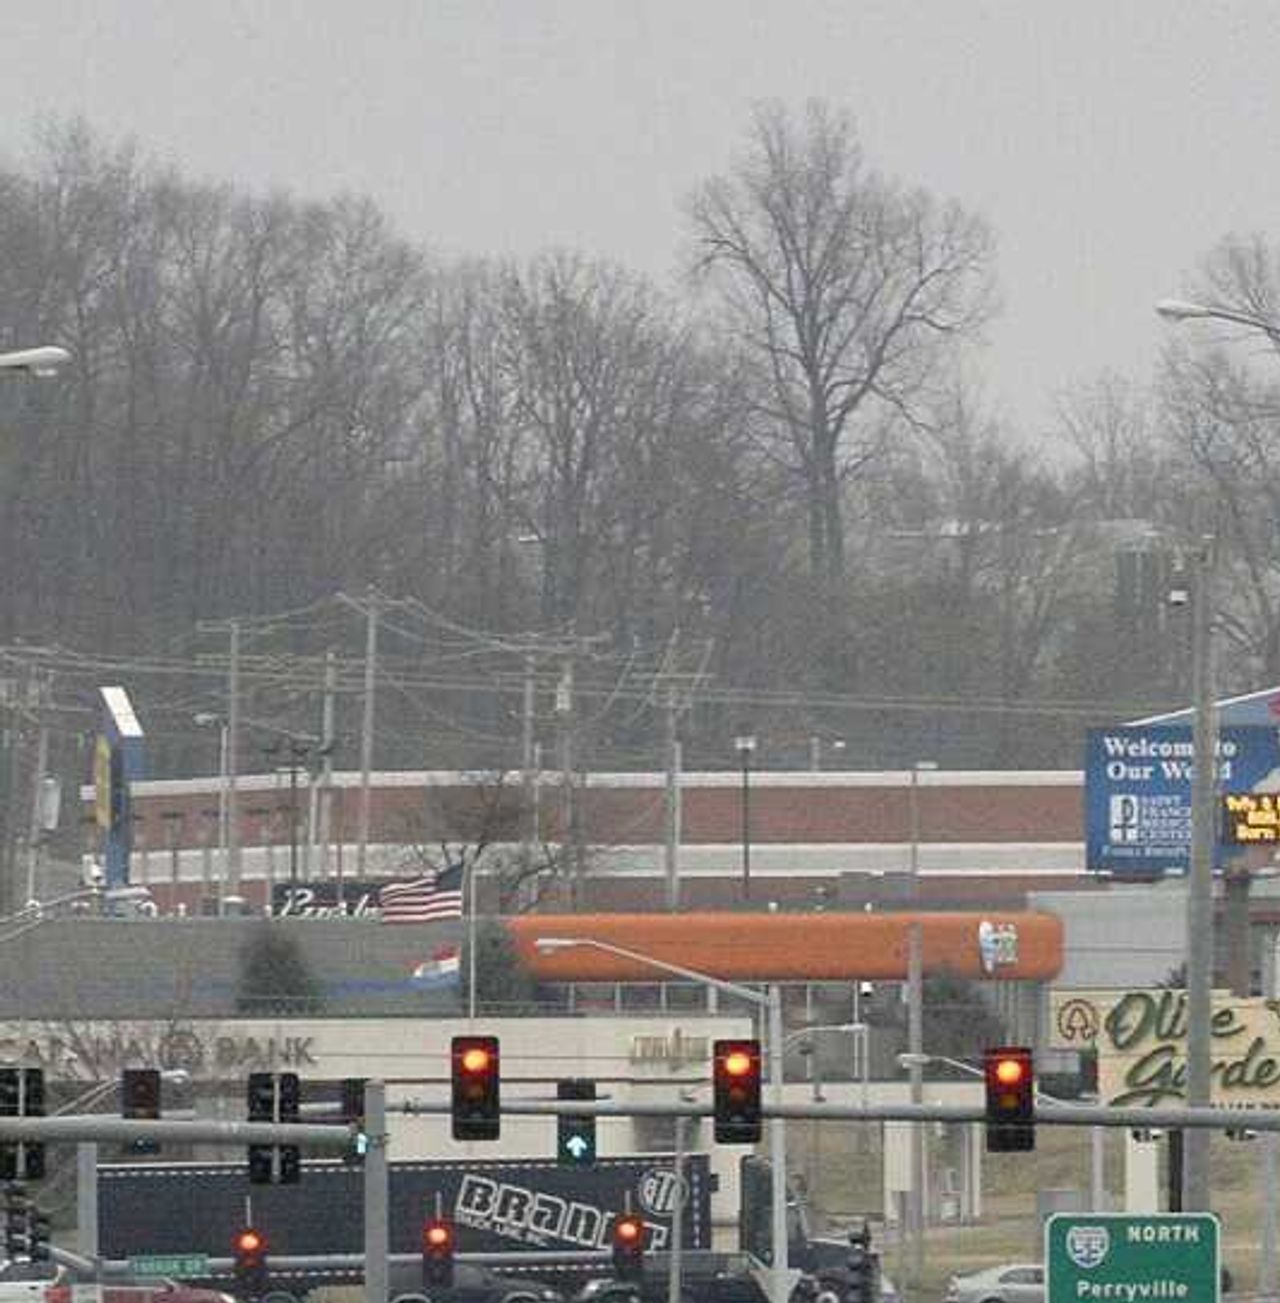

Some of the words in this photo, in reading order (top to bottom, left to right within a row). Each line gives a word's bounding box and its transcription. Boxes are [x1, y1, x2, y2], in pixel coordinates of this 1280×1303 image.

[1104, 736, 1193, 756] Welcom
[1107, 760, 1151, 780] Our
[1104, 992, 1245, 1050] Olie
[214, 1036, 318, 1068] BANK
[1127, 1225, 1200, 1243] NORTH
[1076, 1279, 1189, 1302] Perryville
